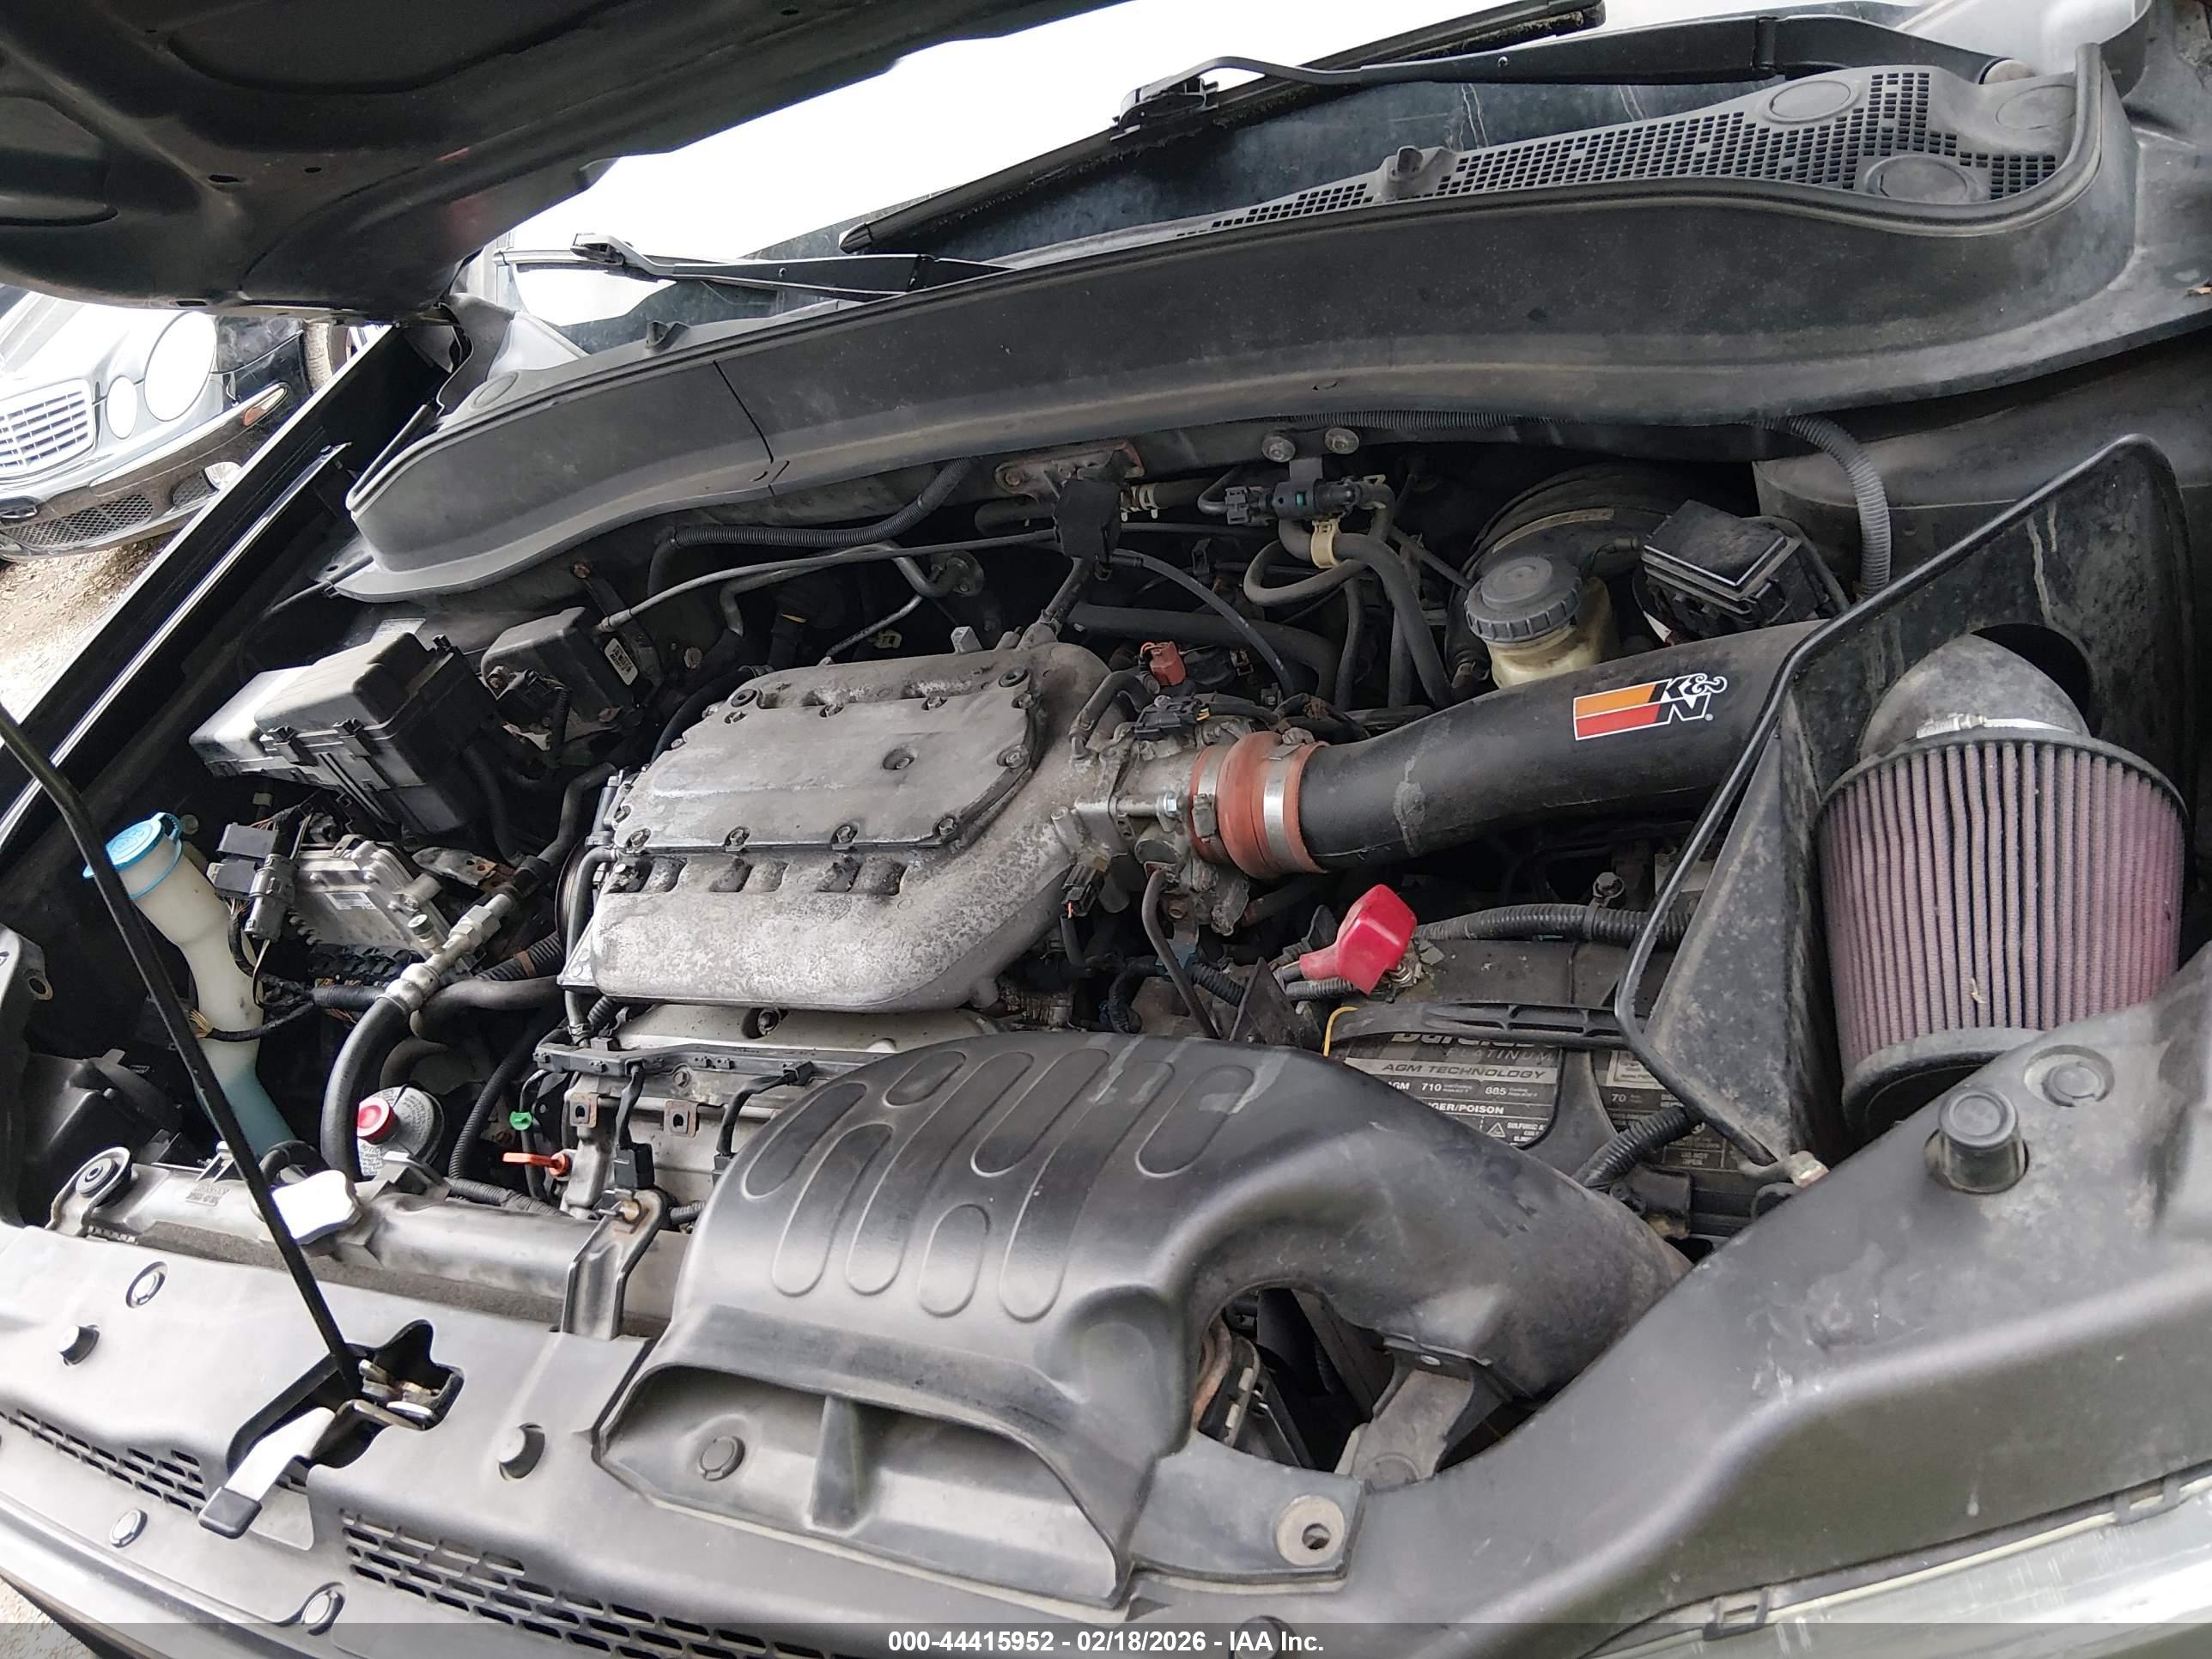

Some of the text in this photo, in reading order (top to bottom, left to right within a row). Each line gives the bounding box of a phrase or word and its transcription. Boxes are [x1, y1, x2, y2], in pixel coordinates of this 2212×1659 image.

[1648, 672, 1728, 723] K&N
[1446, 1047, 1553, 1062] PLATINUM
[1382, 1063, 1546, 1079] AGM TECHNOLOGY
[1421, 1082, 1442, 1092] 710
[1485, 1086, 1507, 1096] 885
[1611, 1093, 1627, 1103] 70
